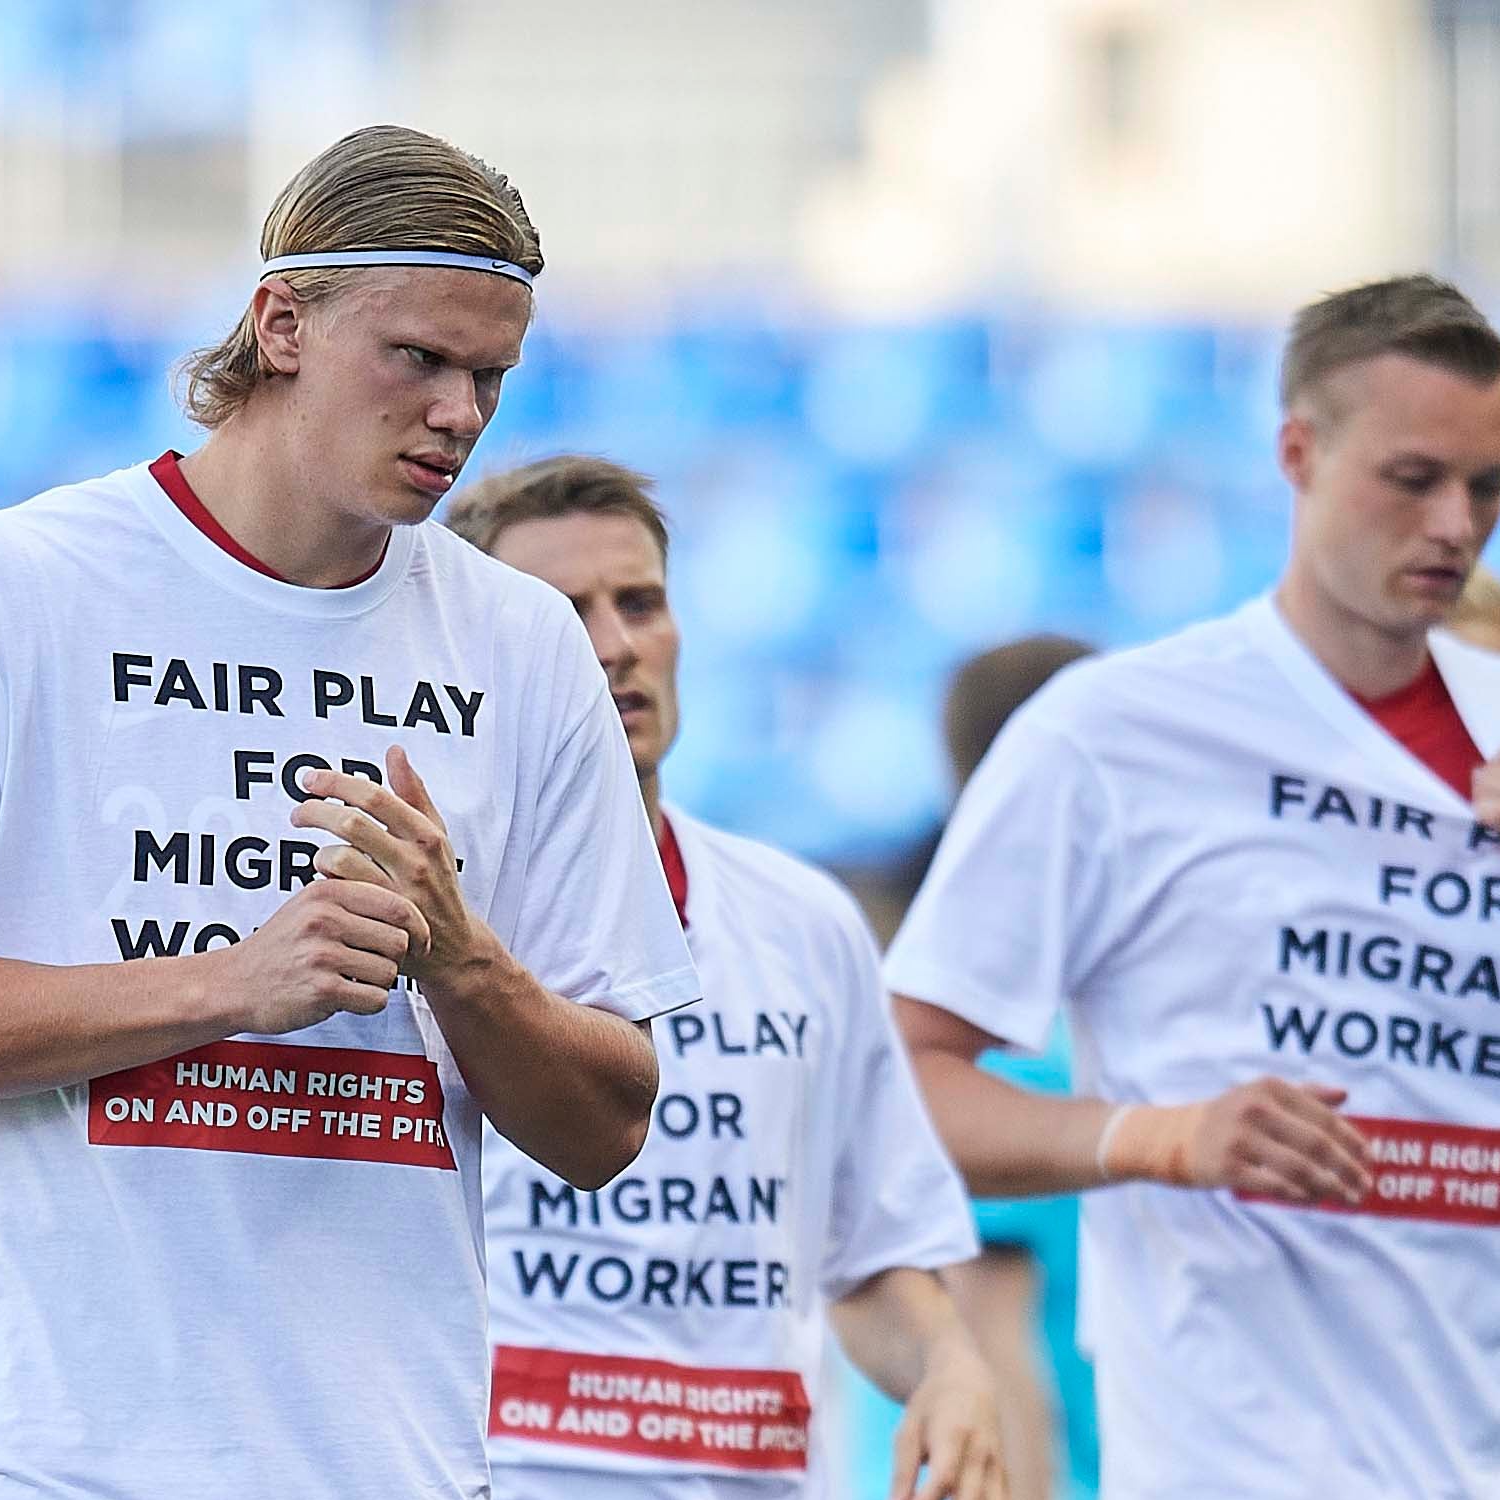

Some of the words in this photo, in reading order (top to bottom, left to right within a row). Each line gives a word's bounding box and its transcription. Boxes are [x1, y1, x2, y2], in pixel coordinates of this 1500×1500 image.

[112, 652, 285, 717] FAIR
[313, 669, 484, 737] PLAY
[1269, 774, 1435, 838] FAIR
[672, 1012, 807, 1059] PLAY
[176, 1062, 295, 1094] HUMAN
[307, 1072, 425, 1104] RIGHTS
[105, 1098, 154, 1122] ON
[164, 1100, 238, 1127] AND
[247, 1106, 310, 1133] OFF
[321, 1111, 381, 1138] THE
[658, 1093, 745, 1140] OR
[531, 1176, 785, 1227] MIGRAN
[1377, 1175, 1434, 1200] OFF
[1444, 1179, 1499, 1209] THE
[515, 1251, 788, 1307] WORKER
[569, 1372, 681, 1406] HUMAN
[501, 1400, 551, 1429] ON
[557, 1406, 631, 1436] AND
[637, 1415, 693, 1442] OFF
[699, 1422, 754, 1449] THE
